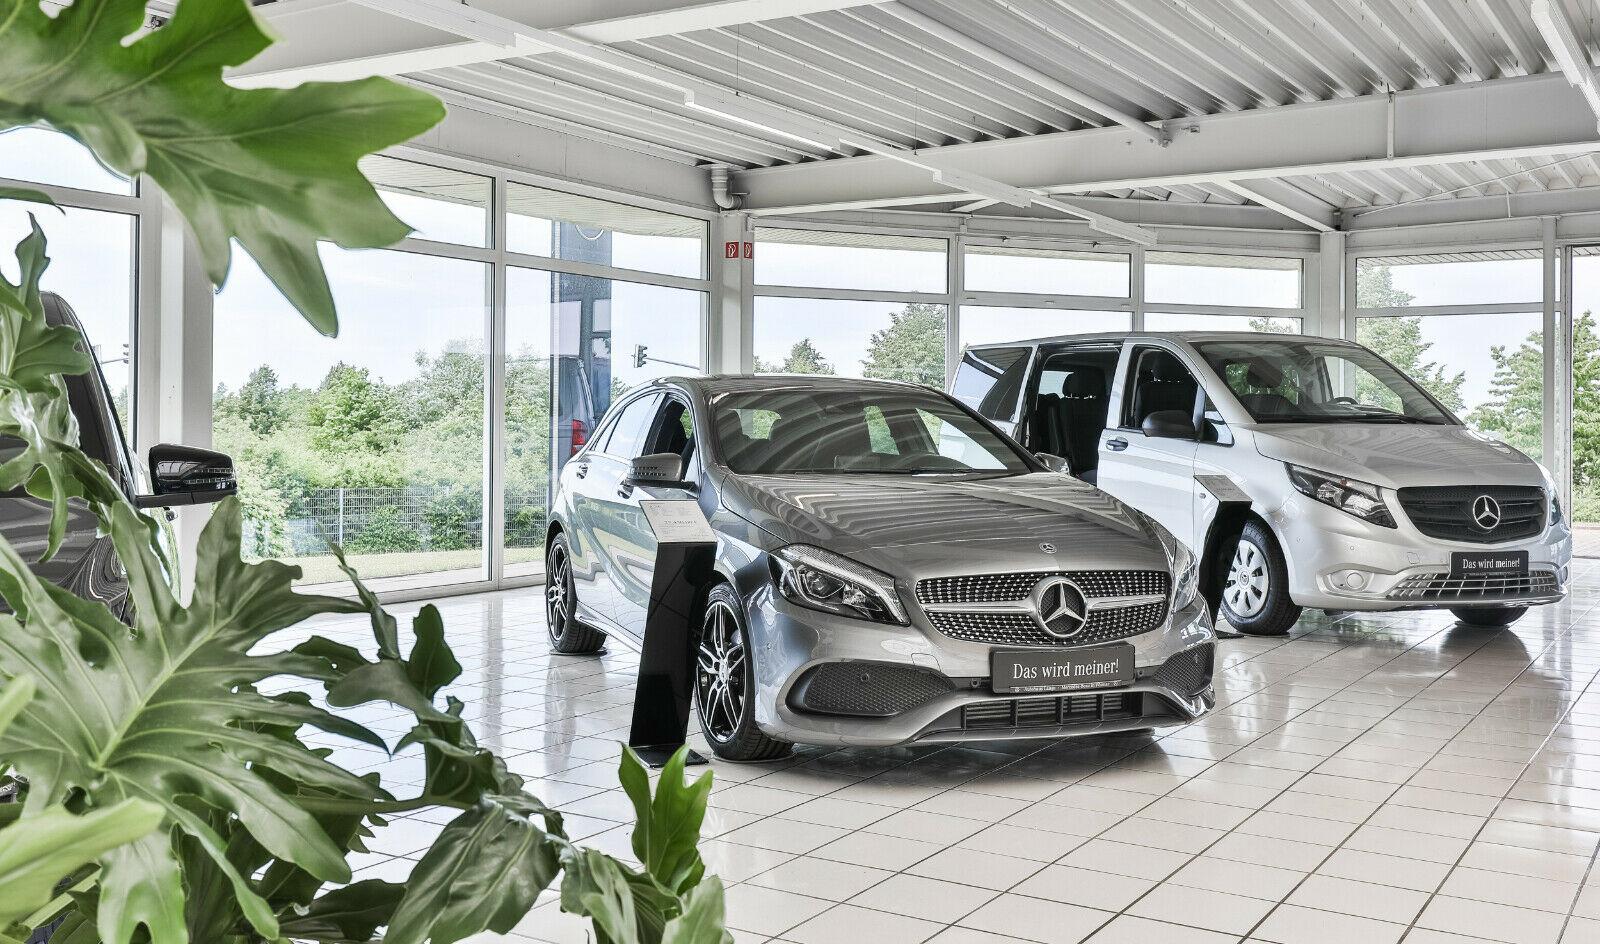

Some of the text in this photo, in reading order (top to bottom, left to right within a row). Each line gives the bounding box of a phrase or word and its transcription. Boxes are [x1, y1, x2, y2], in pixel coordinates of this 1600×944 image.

[1462, 557, 1520, 569] Das wird meiner!
[1013, 658, 1120, 679] Das wird meiner!
